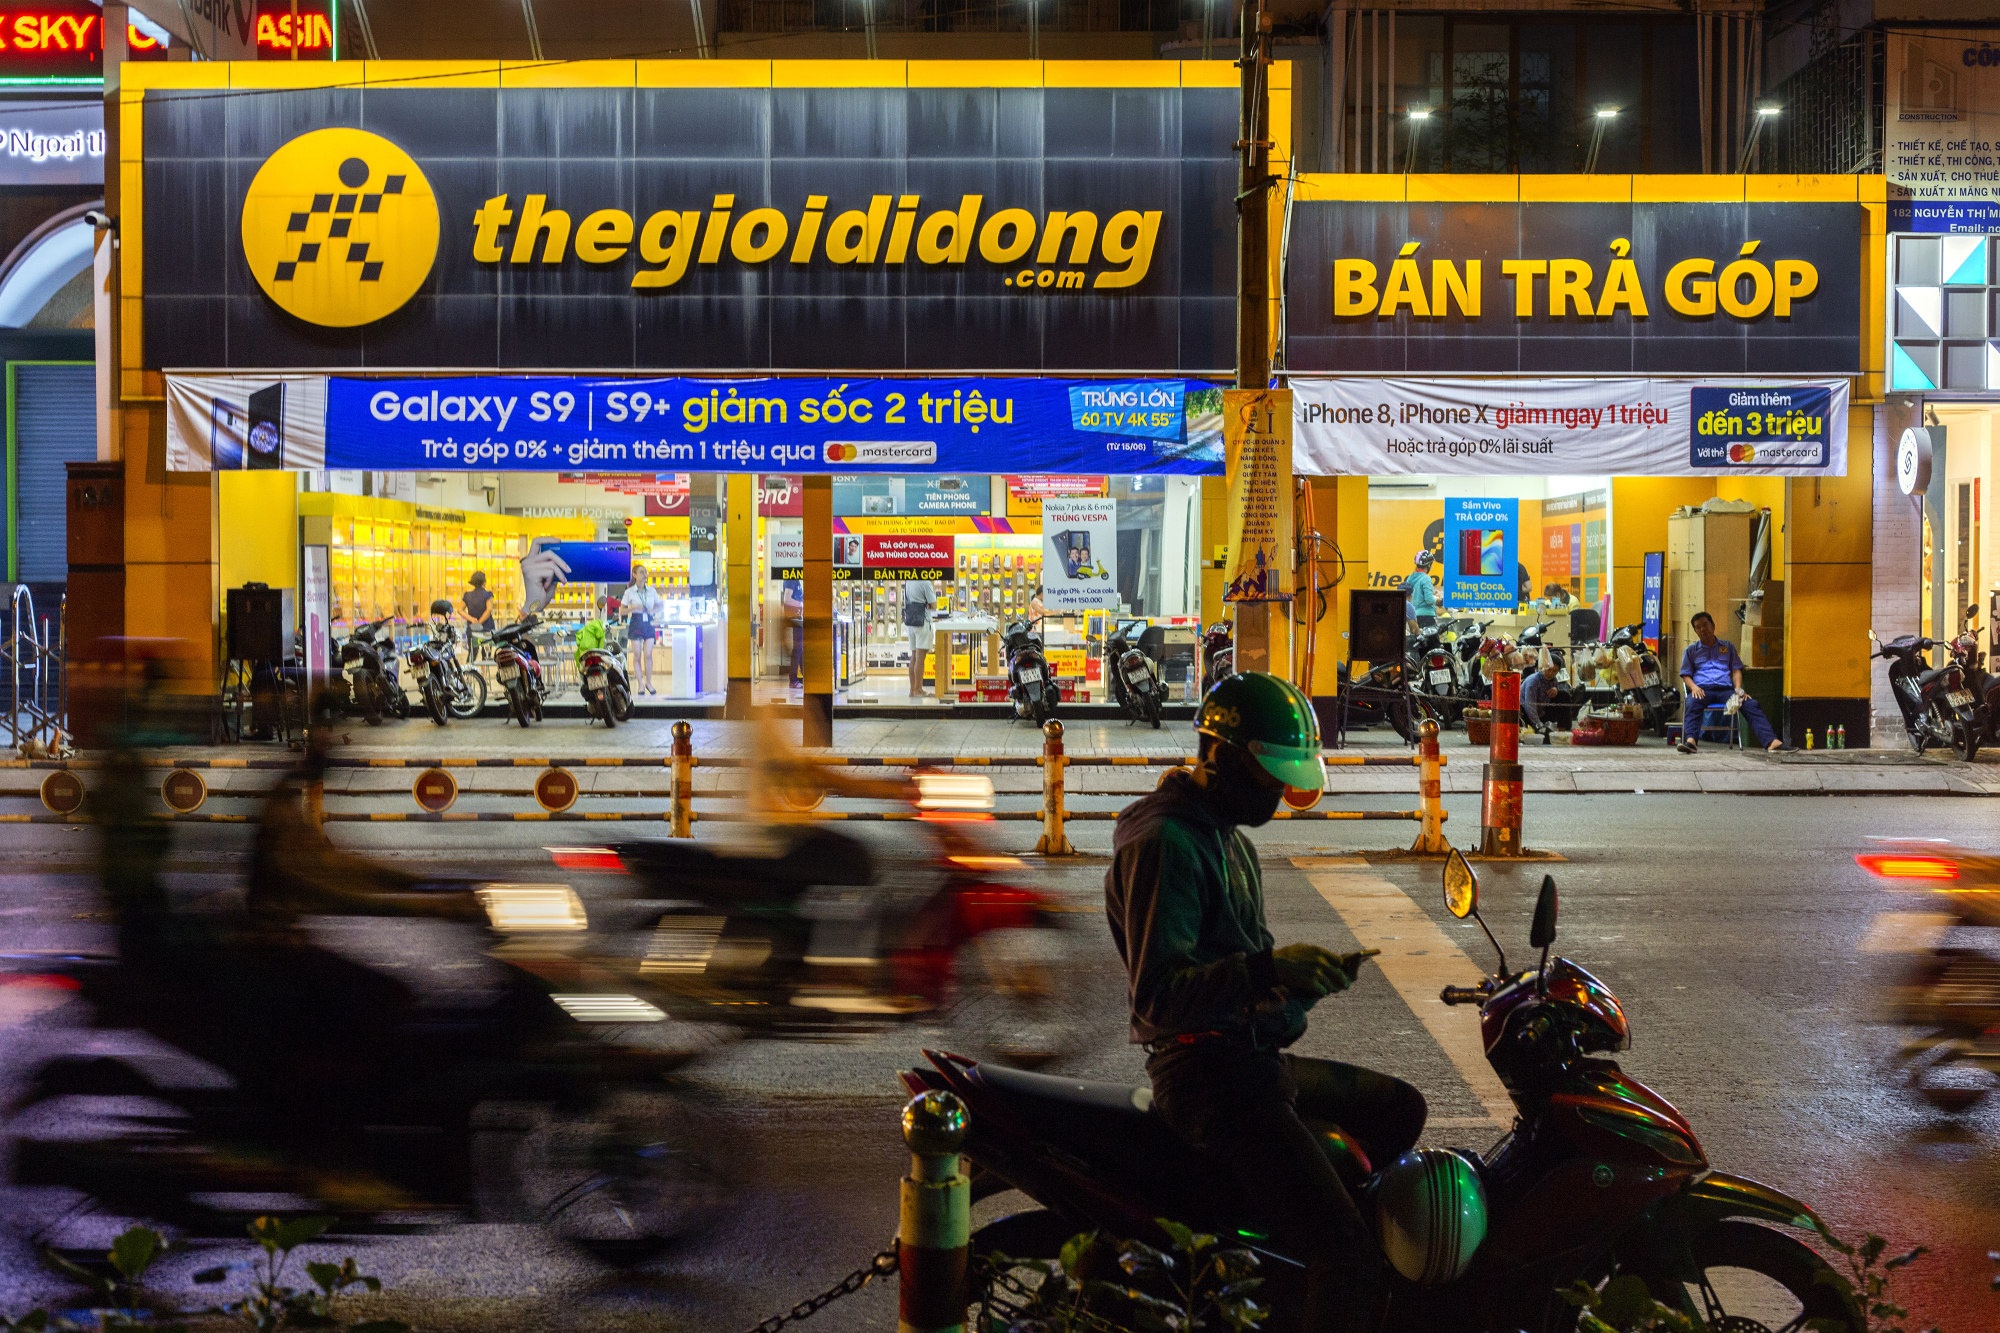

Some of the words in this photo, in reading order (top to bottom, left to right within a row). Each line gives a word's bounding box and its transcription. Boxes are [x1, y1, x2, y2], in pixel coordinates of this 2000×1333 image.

[13, 15, 96, 49] SKY
[10, 130, 83, 160] Ngoại
[1898, 139, 1925, 150] THIẾT
[1928, 139, 1944, 152] KẾ,
[1947, 139, 1967, 150] CHẾ
[1970, 142, 1992, 152] TẠO,
[1898, 153, 1925, 165] THIẾT
[1928, 154, 1945, 167] KẾ,
[1947, 156, 1961, 165] THI
[1965, 154, 1995, 167] CÔNG,
[1898, 169, 1917, 180] SẢN
[1920, 170, 1947, 182] XUẤT,
[1951, 172, 1971, 180] CHO
[1974, 170, 1999, 180] THUÊ
[1897, 185, 1916, 196] SẢN
[1920, 185, 1944, 196] XUẤT
[1948, 188, 1956, 196] XI
[1959, 186, 1988, 196] MĂNG
[1893, 208, 1911, 217] 182
[1914, 204, 1966, 217] NGUYỄN
[1967, 209, 1986, 219] THỊ
[1950, 224, 1984, 232] Email:
[473, 193, 1162, 288] thegioididong
[1005, 269, 1085, 289] .com
[1334, 242, 1481, 317] BÁN
[1502, 237, 1648, 317] TRẢ
[1664, 240, 1819, 318] GÓP
[1082, 388, 1138, 407] TRÚNG
[1140, 388, 1175, 408] LỚN
[1729, 392, 1760, 406] Giảm
[1760, 393, 1792, 406] thêm
[370, 390, 517, 432] Galaxy
[529, 391, 575, 422] S9
[606, 391, 670, 422] S9+
[682, 388, 787, 433] giảm
[799, 384, 873, 423] sốc
[885, 393, 906, 423] 2
[918, 389, 1013, 434] triệu
[1080, 412, 1100, 426] 60
[1103, 412, 1124, 426] TV
[1127, 413, 1149, 427] 4K
[1303, 403, 1374, 424] iPhone
[1377, 403, 1395, 427] 8,
[1400, 403, 1470, 424] iPhone
[1473, 404, 1489, 424] X
[1495, 401, 1547, 429] giảm
[1552, 408, 1602, 429] ngay
[1607, 404, 1615, 424] 1
[1620, 402, 1669, 430] triệu
[1697, 408, 1743, 435] đến
[1746, 412, 1762, 435] 3
[1765, 409, 1822, 441] triệu
[421, 437, 457, 458] Trả
[463, 437, 509, 464] góp
[515, 440, 547, 458] 0%
[568, 438, 625, 465] giảm
[633, 439, 694, 459] thêm
[699, 441, 705, 459] 1
[713, 439, 765, 466] triệu
[770, 445, 815, 467] qua
[862, 447, 932, 457] mastercard
[1387, 437, 1423, 457] Hoặc
[1426, 436, 1446, 453] trả
[1448, 437, 1476, 457] góp
[1479, 440, 1501, 454] 0%
[1502, 437, 1519, 453] lãi
[1521, 437, 1553, 454] suất
[1759, 448, 1818, 457] mastercard
[943, 493, 971, 501] PHONG
[918, 501, 950, 509] CAMERA
[951, 501, 977, 509] PHONE
[1045, 504, 1065, 512] Nokia
[1072, 504, 1087, 513] plus
[1100, 503, 1114, 511] mới
[1483, 501, 1501, 510] Vivo
[523, 508, 577, 518] HUAWEI
[581, 508, 601, 518] P20
[605, 508, 624, 519] Pro
[1051, 512, 1080, 522] TRÚNG
[1082, 514, 1108, 522] VESPA
[1455, 511, 1473, 522] TRẢ
[1474, 511, 1494, 522] GÓP
[1495, 513, 1509, 522] 0%
[691, 525, 707, 535] Pro
[880, 540, 892, 549] TRẢ
[893, 540, 908, 549] GÓP
[866, 550, 884, 560] TẶNG
[886, 550, 908, 559] THÙNG
[782, 569, 803, 579] BÁN
[874, 569, 896, 579] BÁN
[898, 568, 918, 579] TRẢ
[921, 569, 943, 579] GÓP
[1047, 587, 1058, 595] Trả
[1058, 588, 1069, 597] góp
[1456, 581, 1478, 591] Tặng
[1451, 592, 1473, 600] PMH
[1474, 592, 1513, 601] 300.000
[1645, 594, 1659, 624] ĐIỆN
